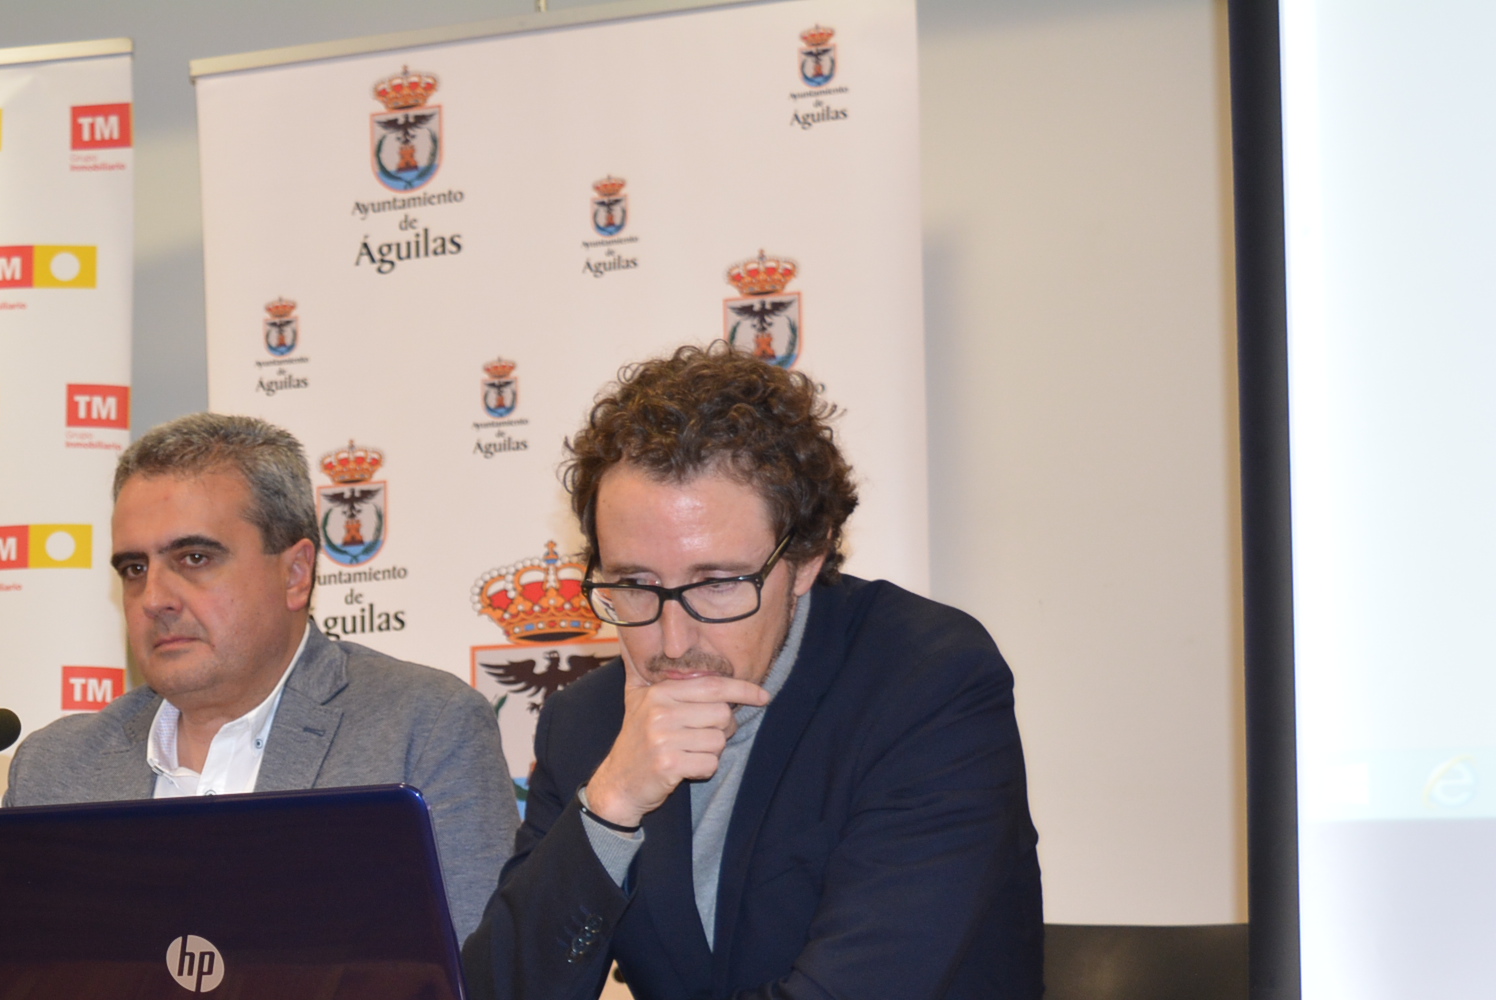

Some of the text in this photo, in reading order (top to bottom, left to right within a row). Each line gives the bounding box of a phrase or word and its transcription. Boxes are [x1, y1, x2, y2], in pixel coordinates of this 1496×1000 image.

[78, 115, 119, 141] TM
[790, 106, 848, 130] Águilas
[351, 190, 464, 221] Ayuntamiento
[399, 214, 418, 231] de
[354, 228, 462, 275] Águilas
[582, 256, 638, 278] Águilas
[255, 375, 309, 397] Águilas
[74, 395, 117, 420] TM
[473, 436, 529, 459] Águilas
[317, 566, 408, 586] untamiento
[344, 588, 363, 605] de
[69, 677, 113, 703] TM
[175, 935, 217, 992] hp
